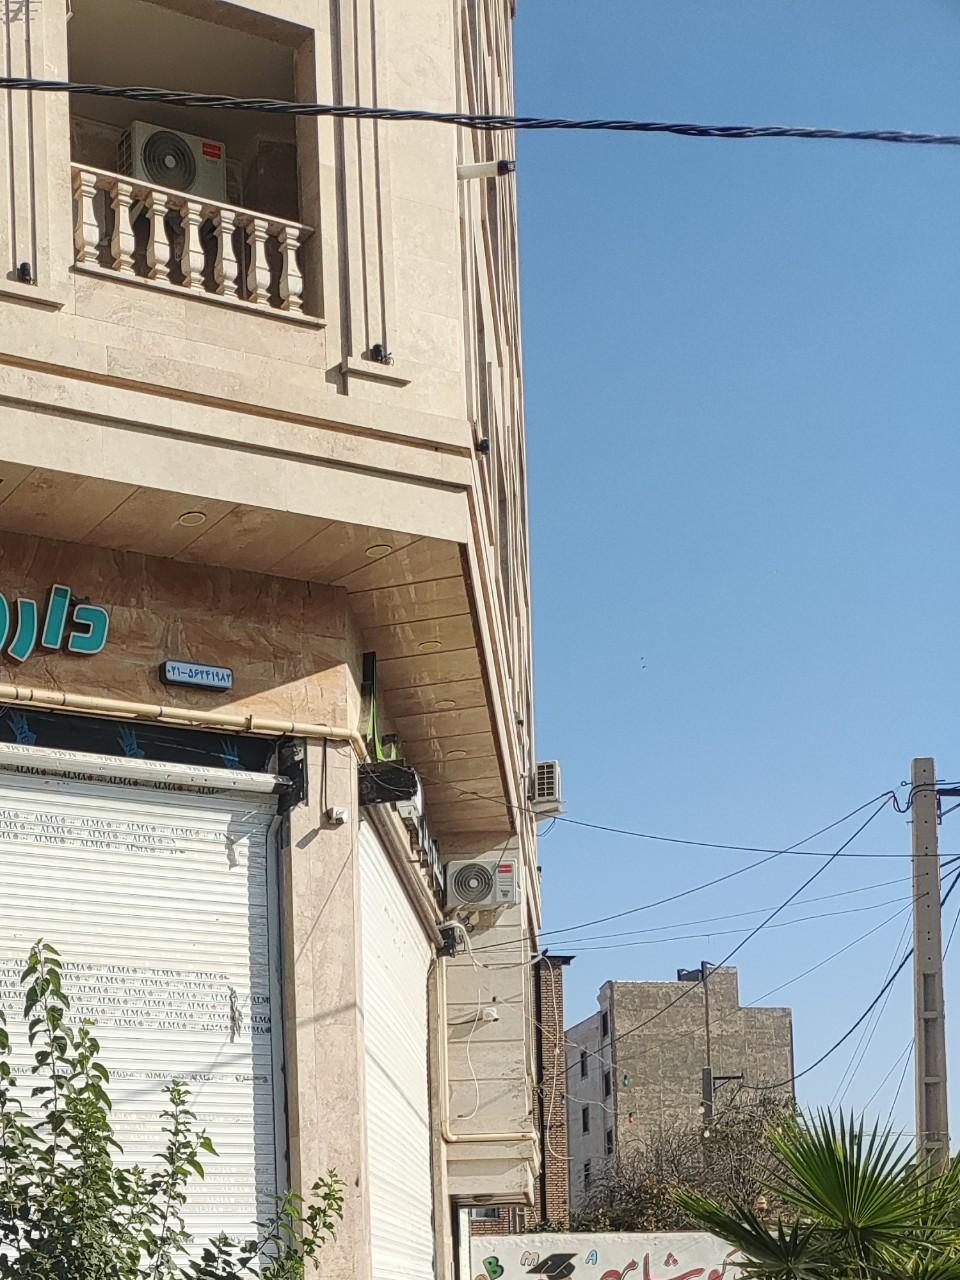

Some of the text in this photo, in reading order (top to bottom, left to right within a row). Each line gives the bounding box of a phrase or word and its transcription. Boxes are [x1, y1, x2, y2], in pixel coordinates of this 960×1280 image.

[14, 765, 40, 776] ALMA
[62, 771, 88, 781] ALMA
[107, 776, 132, 786] ALMA
[153, 781, 176, 791] ALMA
[585, 1249, 598, 1265] A
